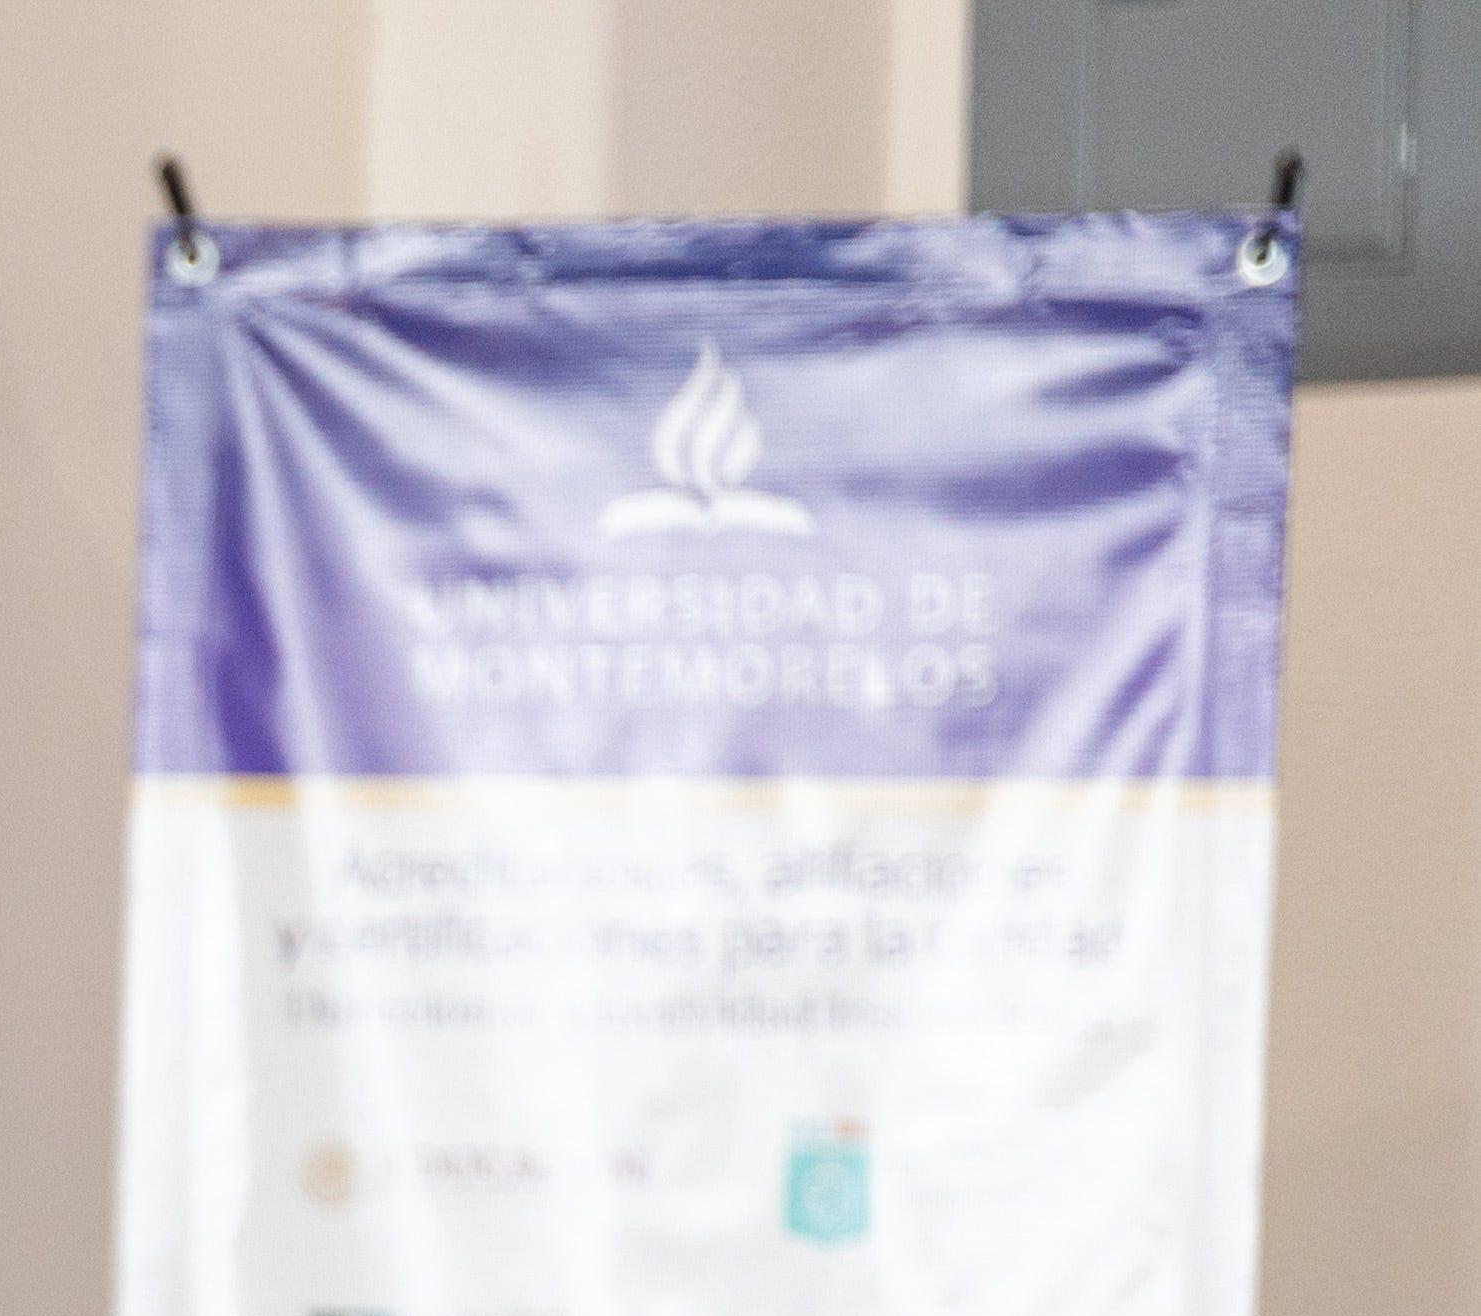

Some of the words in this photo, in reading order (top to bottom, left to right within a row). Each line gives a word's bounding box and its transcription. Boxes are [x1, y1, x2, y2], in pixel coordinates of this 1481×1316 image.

[404, 572, 886, 637] UNIVERSIDAD
[909, 571, 1000, 635] DE
[409, 643, 1000, 708] MONTEMORELOS
